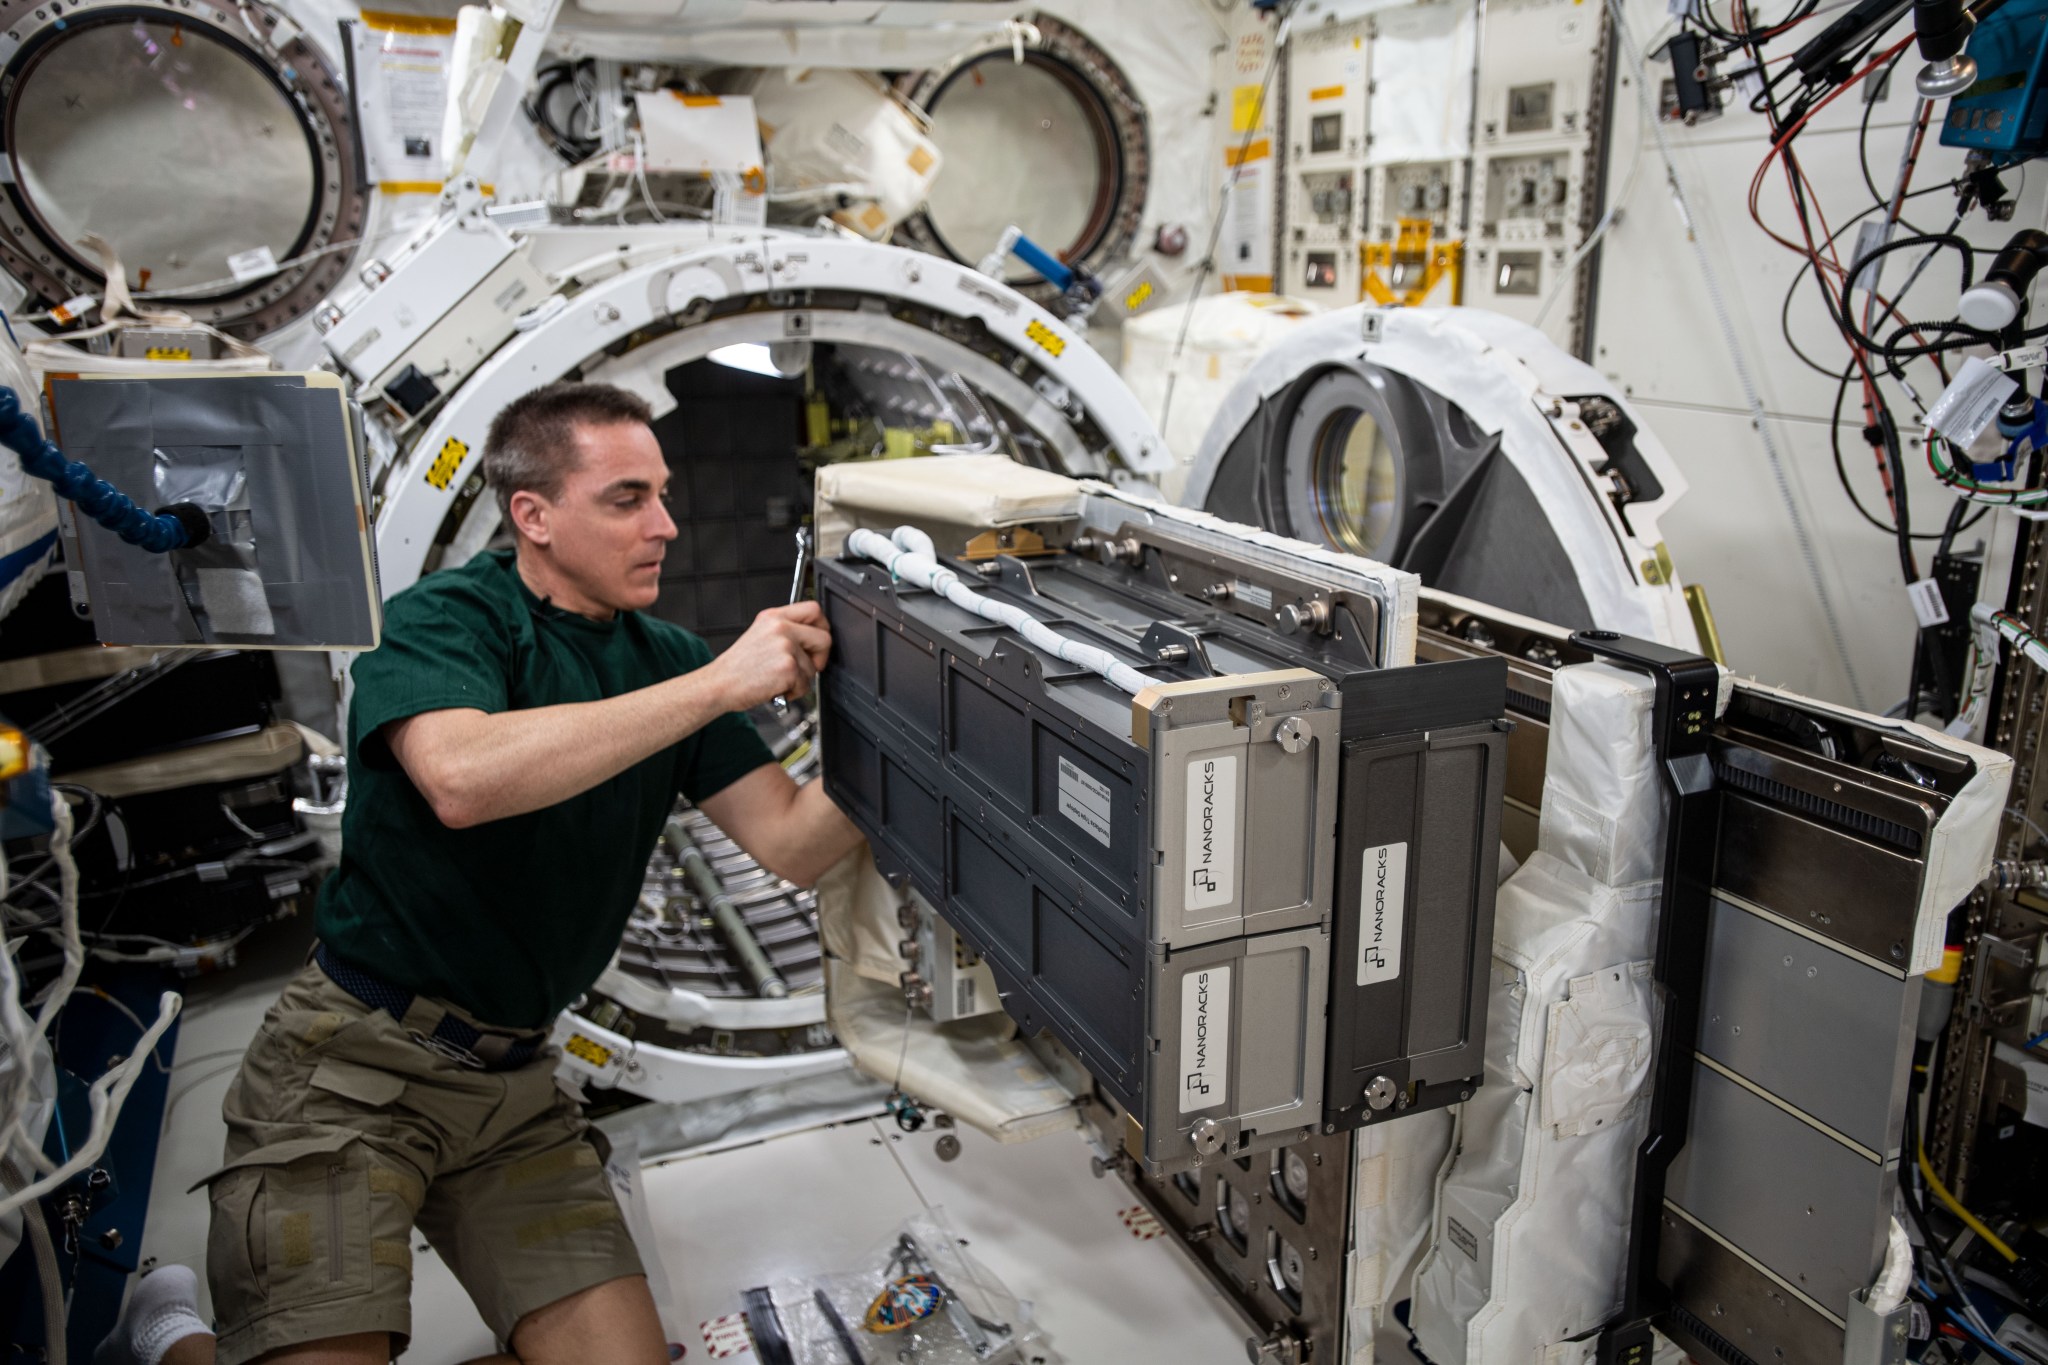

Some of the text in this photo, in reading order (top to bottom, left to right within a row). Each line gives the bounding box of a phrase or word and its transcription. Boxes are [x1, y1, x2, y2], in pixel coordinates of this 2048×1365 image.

[1202, 761, 1215, 864] NANORACKS
[1373, 847, 1388, 943] NANORACKS
[1196, 973, 1209, 1069] NANORACKS
